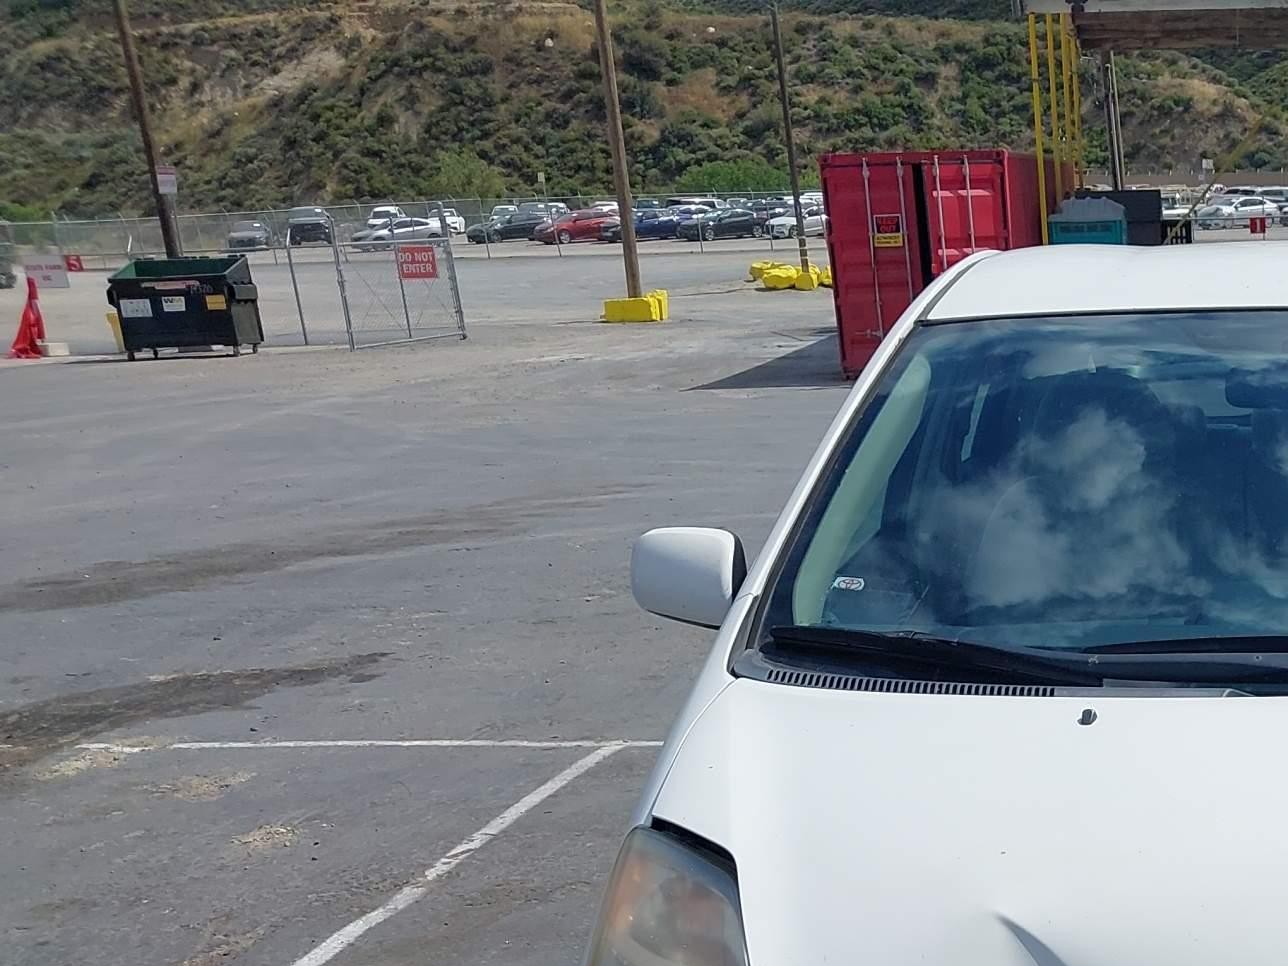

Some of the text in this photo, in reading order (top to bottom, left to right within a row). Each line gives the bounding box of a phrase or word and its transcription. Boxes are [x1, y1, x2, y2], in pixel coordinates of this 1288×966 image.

[399, 252, 433, 262] DO NOT
[402, 263, 434, 273] ENTER
